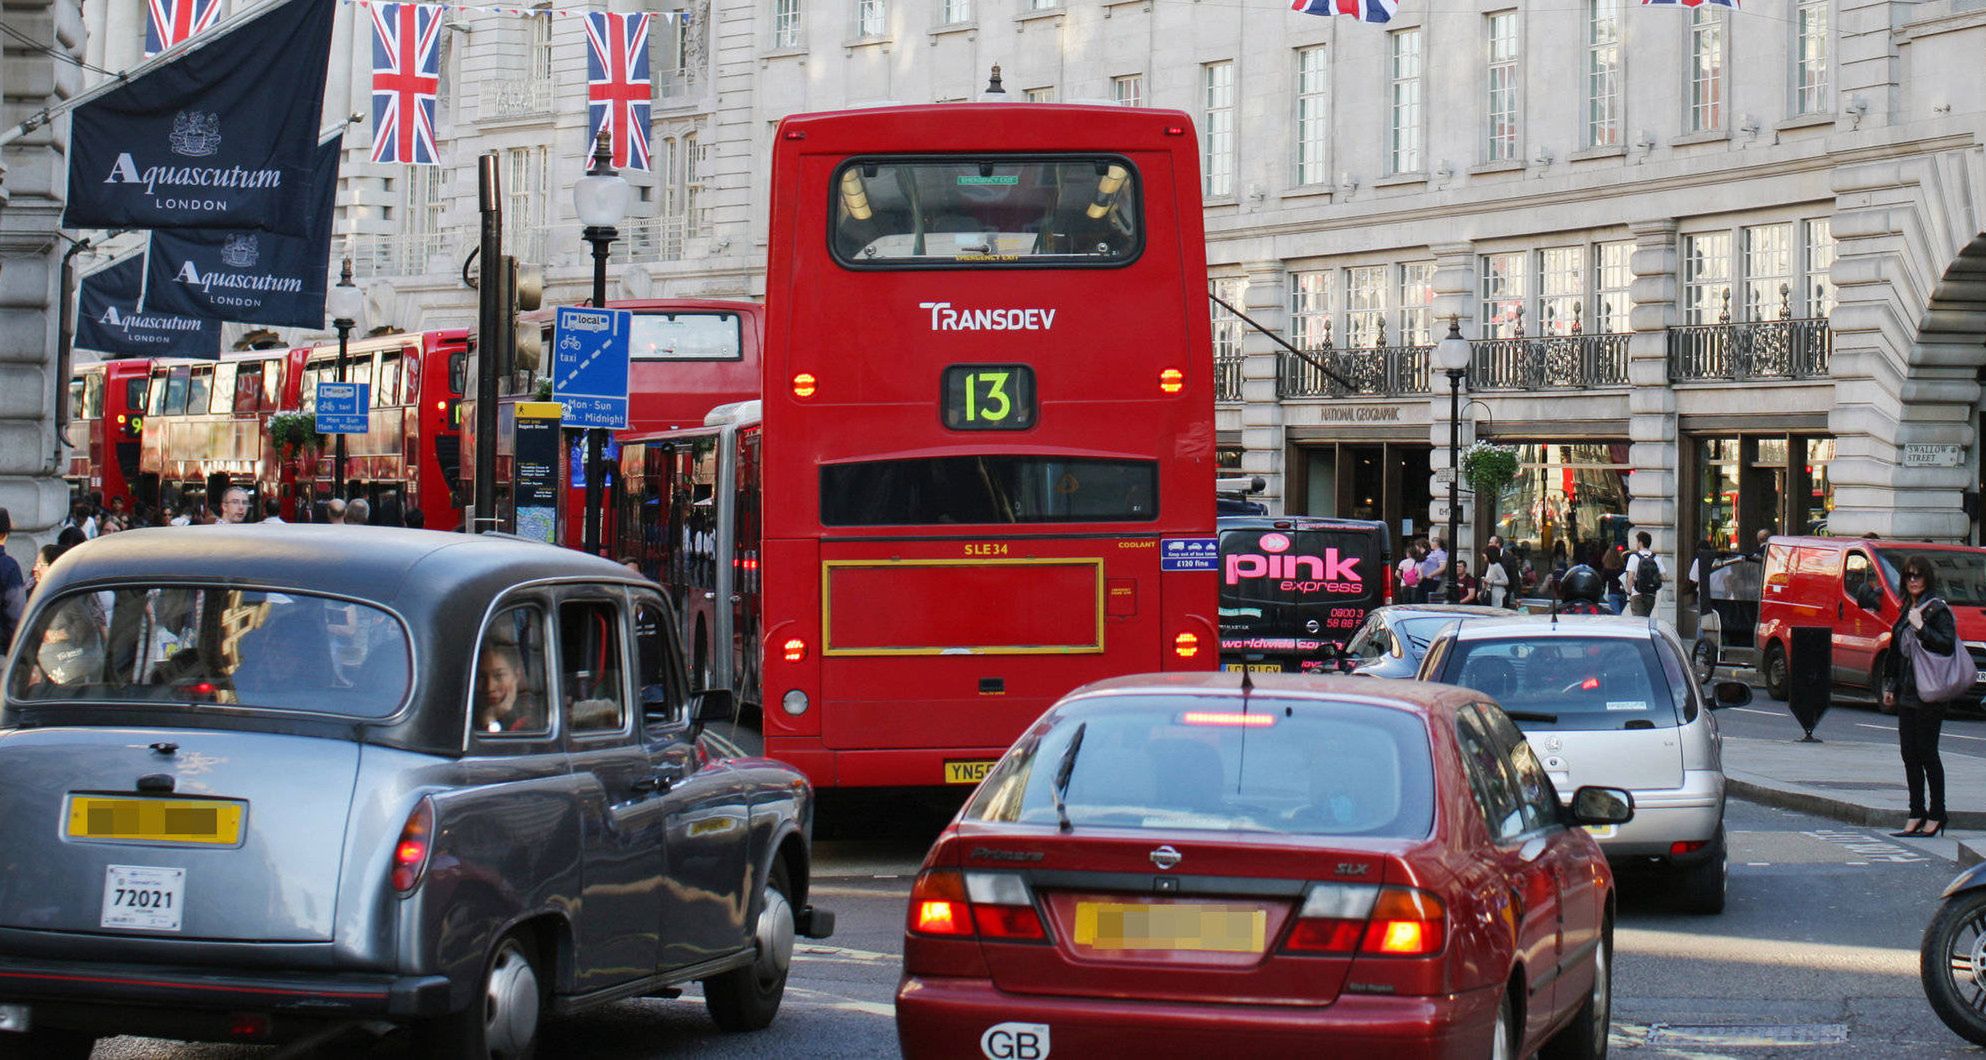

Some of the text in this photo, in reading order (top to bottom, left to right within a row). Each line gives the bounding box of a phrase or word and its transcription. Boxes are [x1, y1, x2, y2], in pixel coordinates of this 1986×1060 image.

[103, 152, 281, 195] Aquascutum
[156, 198, 227, 211] LONDON
[172, 260, 302, 293] Aquascutum
[210, 295, 261, 307] LONDON
[99, 306, 201, 333] Aquascutum
[578, 315, 601, 325] local
[919, 302, 1056, 331] TRANSDEV
[128, 334, 170, 343] LONDON
[560, 353, 577, 362] taxi
[965, 372, 1011, 421] 13
[568, 399, 587, 409] Mon
[594, 400, 612, 410] Sun
[585, 413, 624, 425] Midnight
[1321, 406, 1400, 421] NATIONAL GEOGRAPHIC
[1907, 445, 1948, 454] SWALLOW
[1907, 454, 1936, 462] STREET
[964, 544, 1009, 555] SLE34
[1118, 541, 1156, 549] COOLANT
[1176, 559, 1209, 568] £120 fine
[1225, 533, 1362, 585] pink
[1280, 580, 1363, 594] express
[1330, 607, 1356, 618] 0800
[1221, 638, 1296, 649] worldwide
[1335, 863, 1369, 875] SLX
[114, 889, 173, 908] 72021
[987, 1030, 1041, 1060] GB
